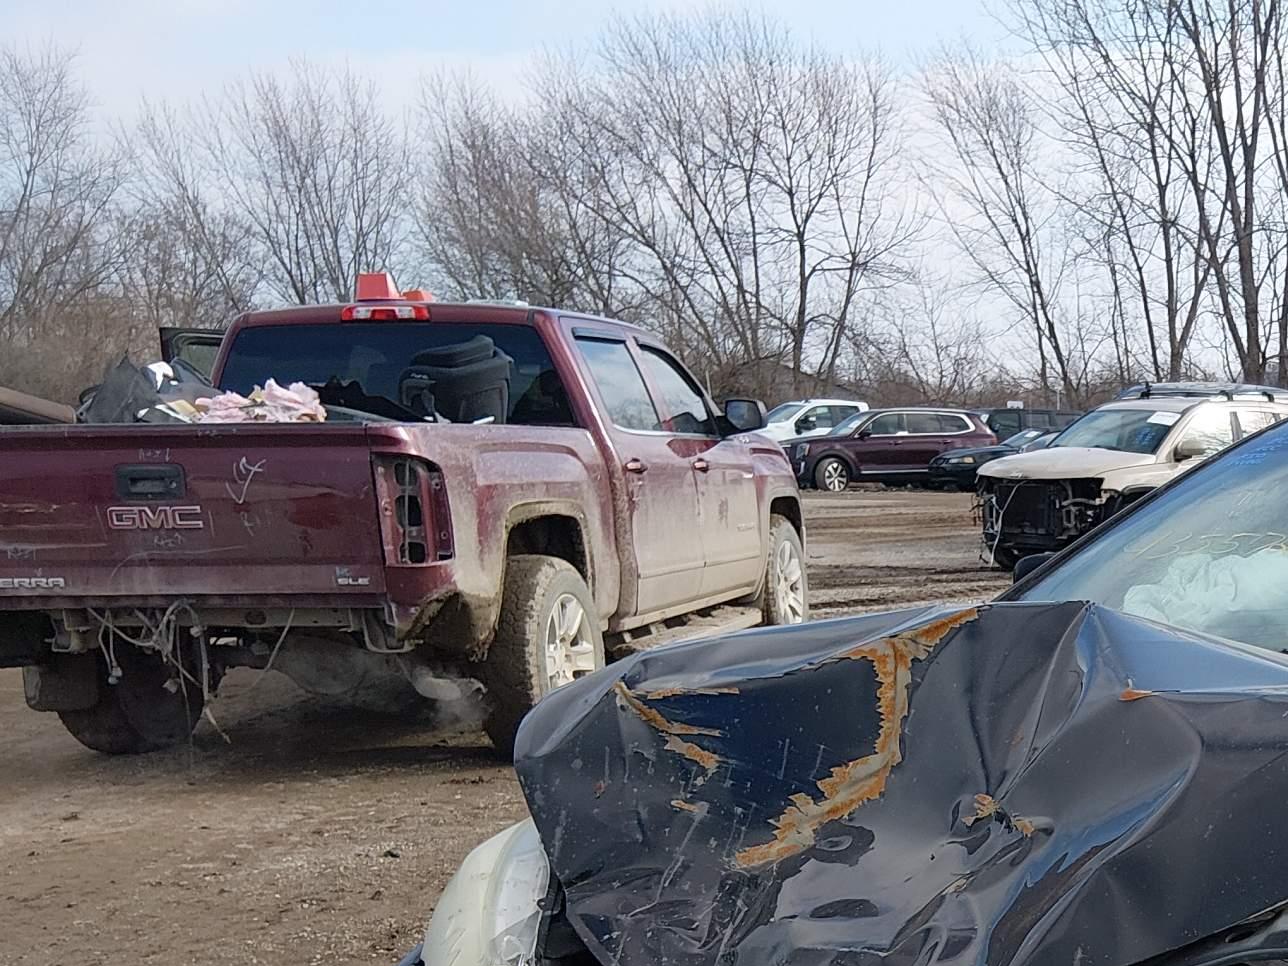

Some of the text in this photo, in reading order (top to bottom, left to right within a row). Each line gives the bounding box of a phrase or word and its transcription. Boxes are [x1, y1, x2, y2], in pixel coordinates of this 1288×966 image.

[106, 505, 204, 530] GMC
[0, 577, 65, 589] ERRA
[337, 577, 370, 585] SLE
